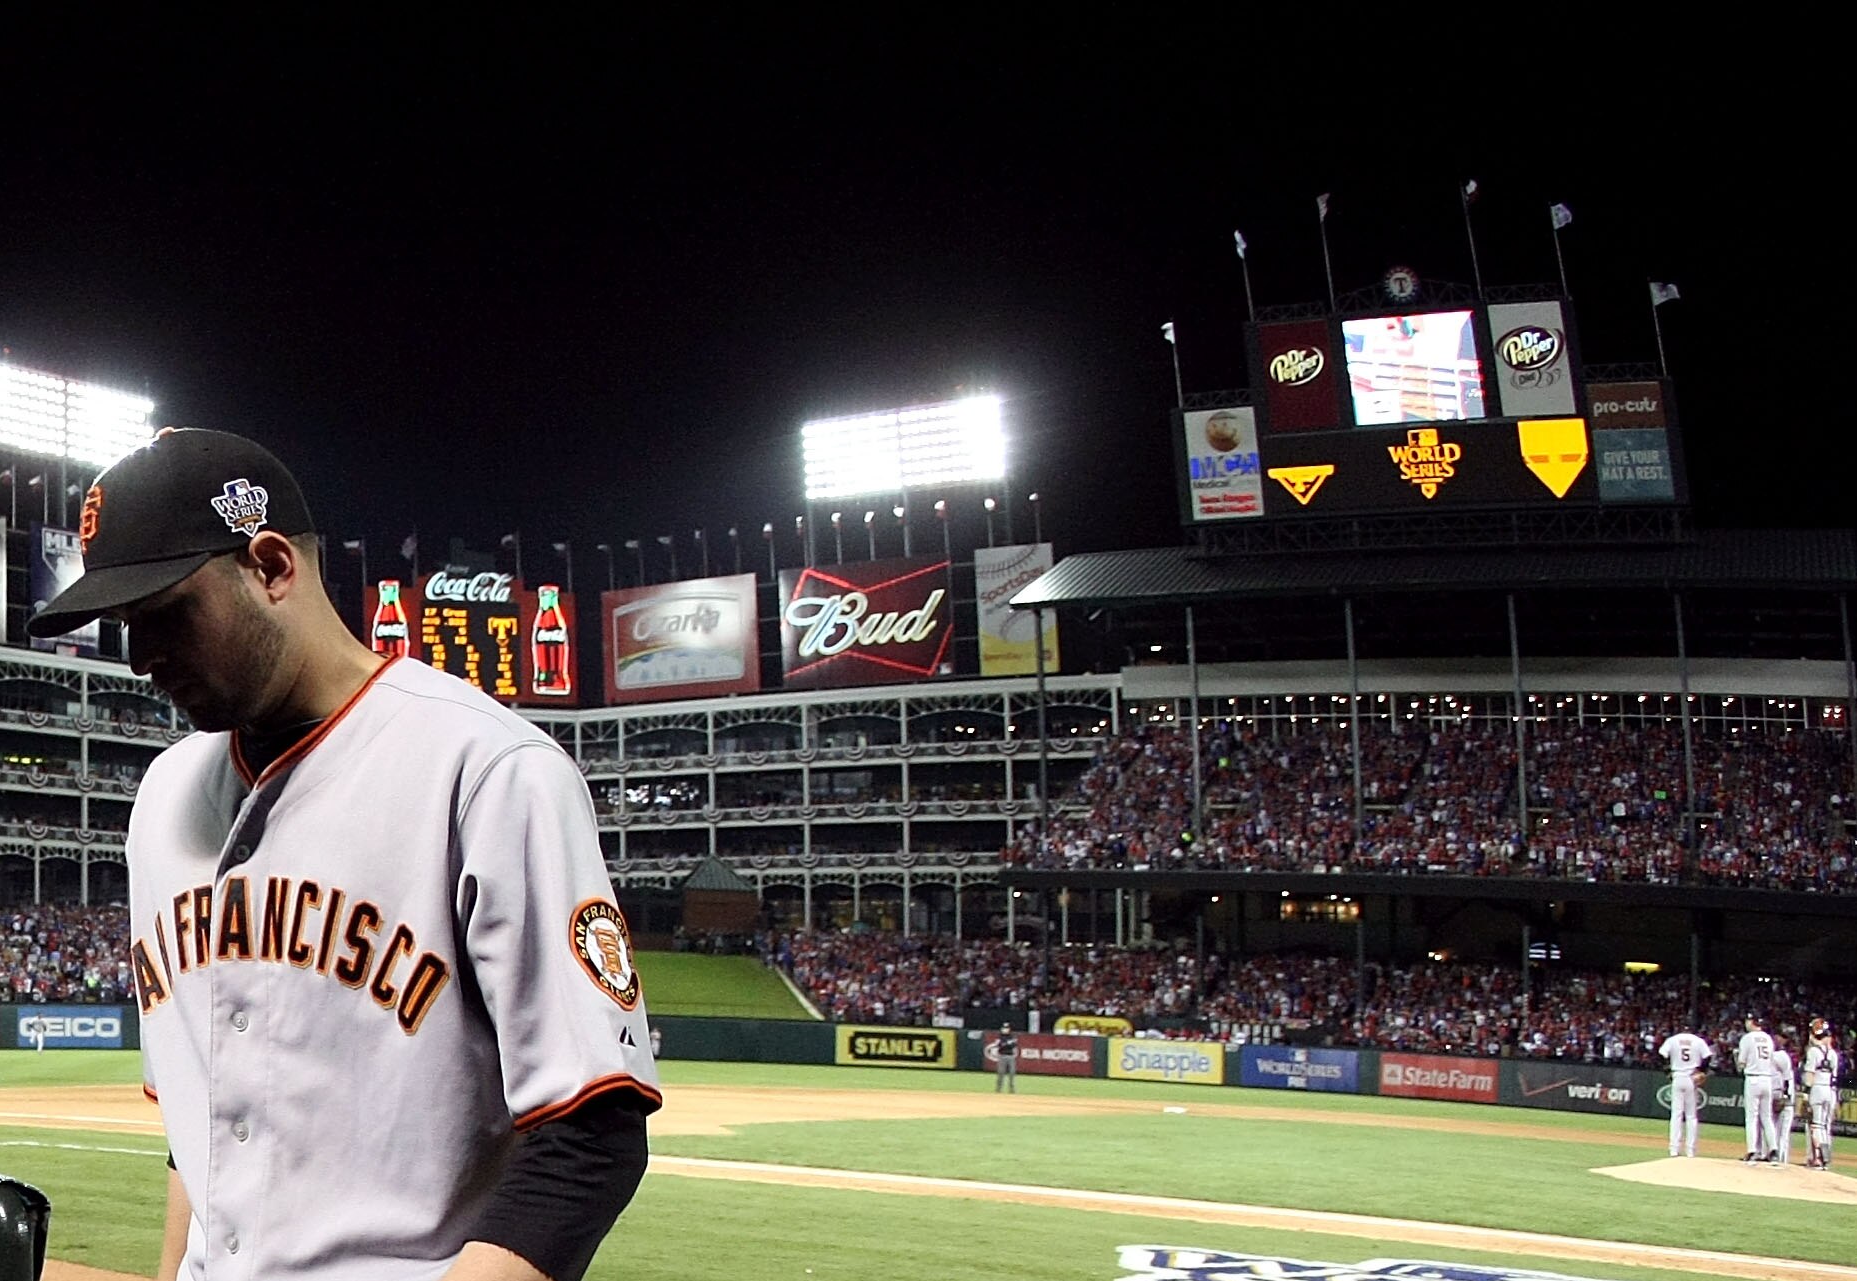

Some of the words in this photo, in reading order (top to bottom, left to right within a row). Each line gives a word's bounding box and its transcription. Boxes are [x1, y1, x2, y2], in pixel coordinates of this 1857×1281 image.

[1520, 332, 1540, 347] Dr
[1288, 349, 1306, 363] Dr
[1510, 337, 1554, 365] Pepper
[1276, 354, 1318, 383] Pepper
[1388, 444, 1461, 464] WORLD
[1400, 461, 1455, 480] SERIES
[214, 490, 265, 511] WORLD
[226, 502, 265, 521] SERIES
[425, 571, 514, 602] Coca-Cola
[785, 588, 945, 657] Bud
[575, 922, 589, 960] SAN
[173, 876, 451, 1037] FRANCISCO
[19, 1017, 122, 1038] GEICO
[854, 1037, 938, 1058] STANLEY
[1042, 1049, 1090, 1062] MOTORS
[1681, 1048, 1690, 1062] 5
[1756, 1045, 1769, 1060] 15
[1121, 1044, 1210, 1078] Snapple
[1568, 1083, 1631, 1102] verizon
